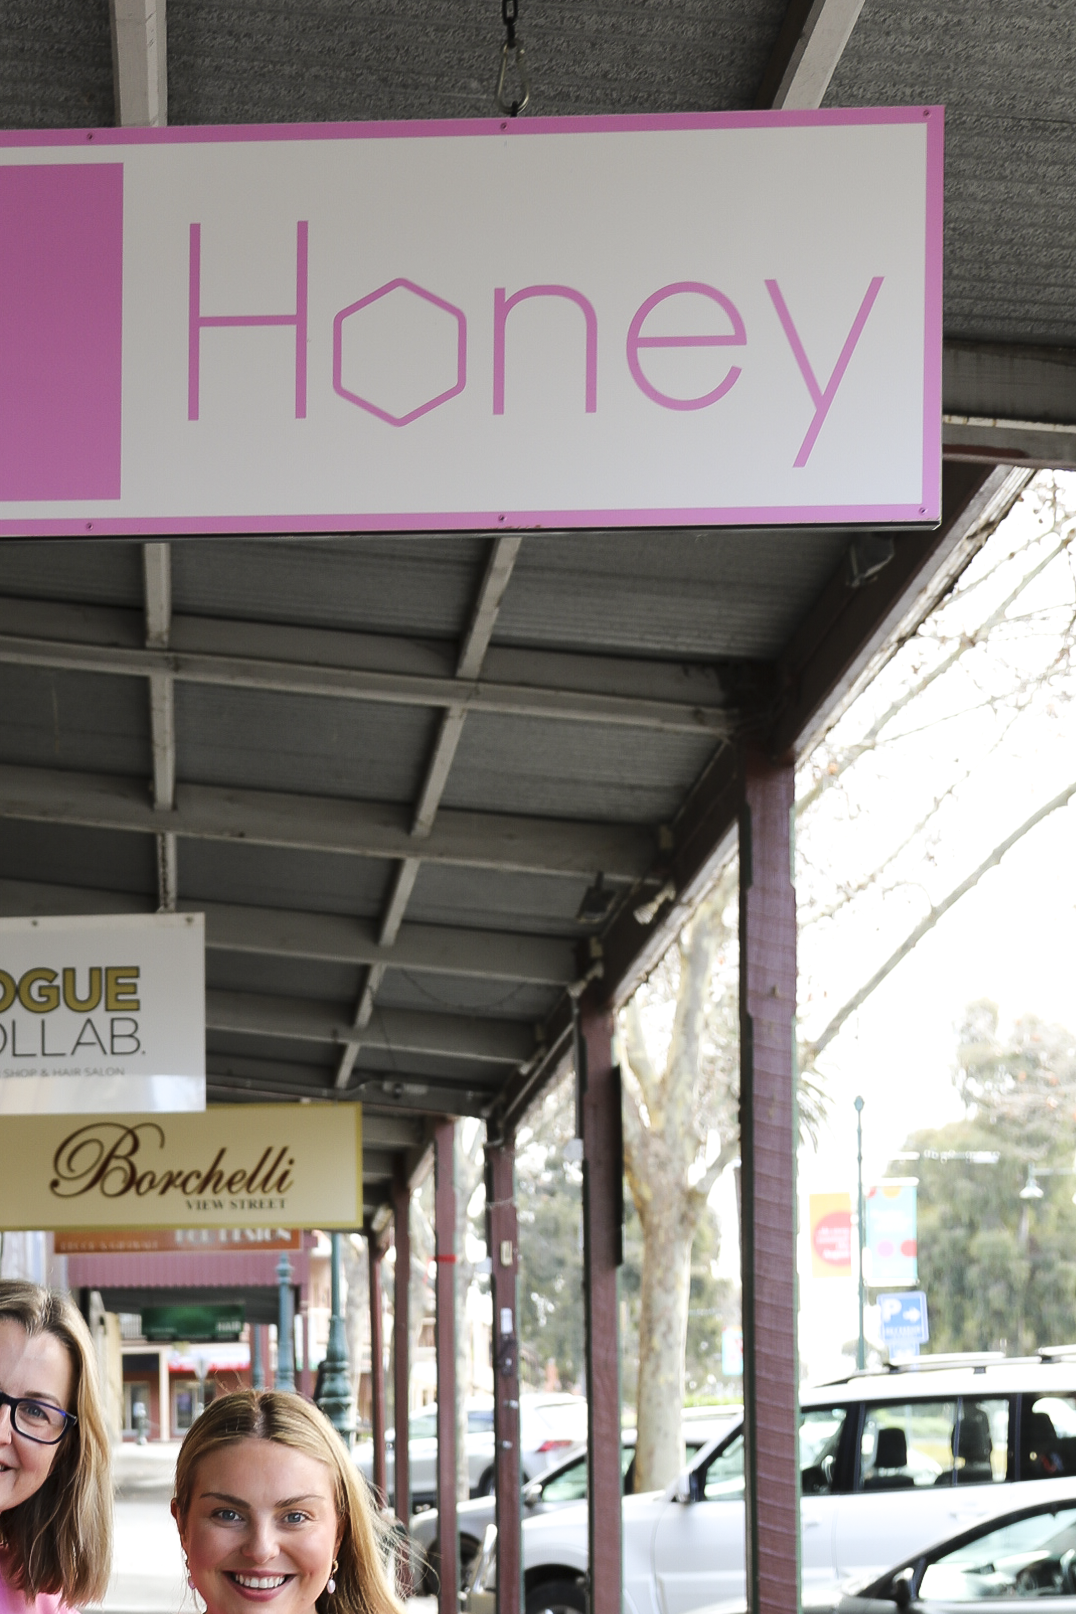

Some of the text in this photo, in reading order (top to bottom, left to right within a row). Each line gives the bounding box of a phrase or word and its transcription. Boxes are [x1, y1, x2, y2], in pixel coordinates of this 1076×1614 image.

[188, 220, 885, 468] Honey
[4, 1068, 38, 1079] SHOP
[41, 1068, 49, 1078] &
[53, 1067, 82, 1077] HAIR
[84, 1066, 126, 1077] SALON
[50, 1122, 294, 1198] Borchelli
[186, 1198, 287, 1210] VIEW STREET
